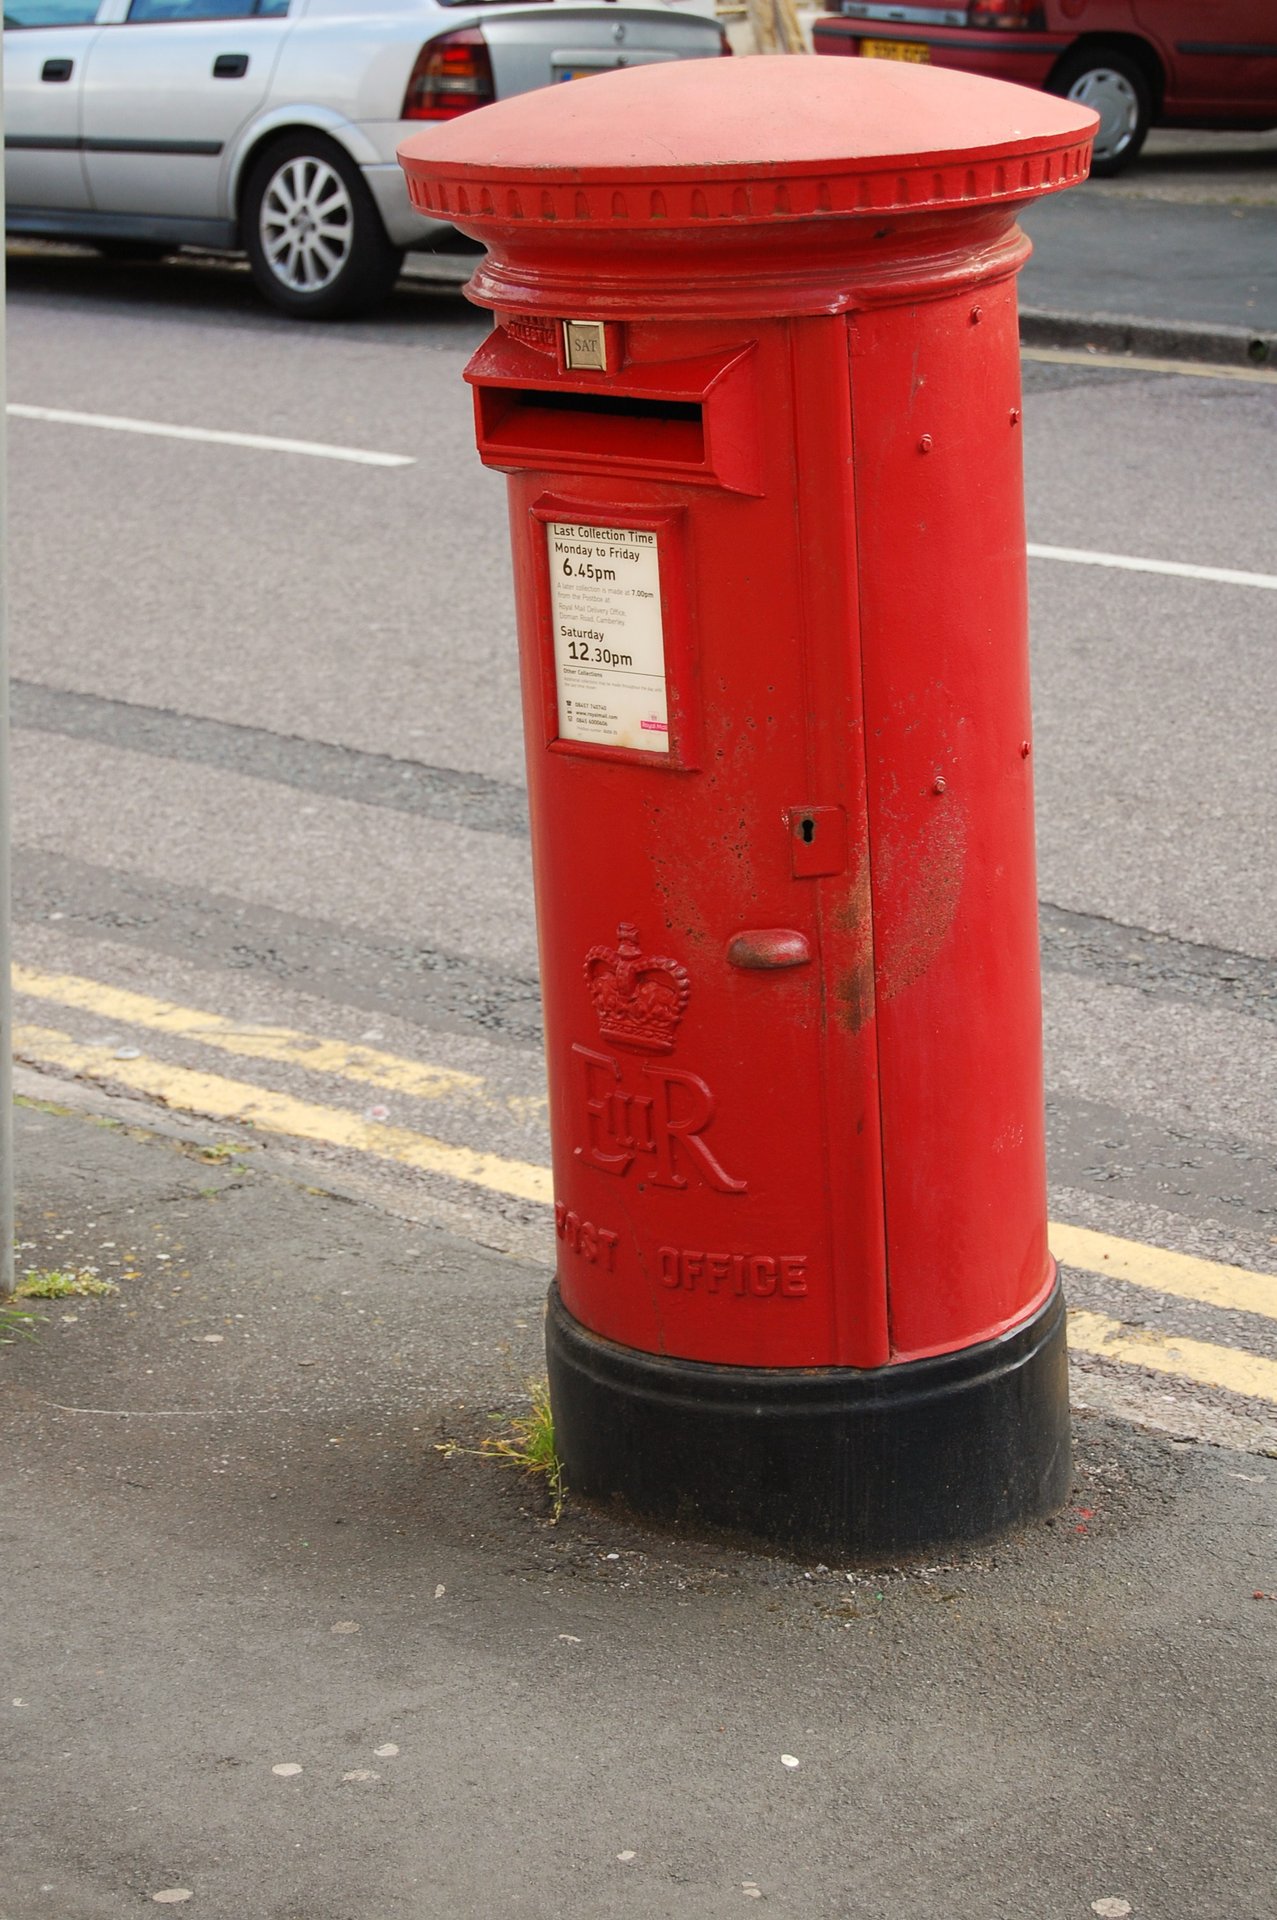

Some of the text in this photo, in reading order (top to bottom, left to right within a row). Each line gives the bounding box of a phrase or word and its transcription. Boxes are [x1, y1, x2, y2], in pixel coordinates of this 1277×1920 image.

[575, 338, 598, 352] SAT
[554, 525, 654, 544] Last Collection Time
[555, 543, 640, 562] Monday to Friday
[563, 558, 616, 582] 6.45pm
[632, 589, 654, 599] 7.00pm
[560, 625, 605, 642] Saturday
[568, 641, 633, 668] 12.30pm
[563, 667, 603, 678] Other Collections
[576, 711, 618, 720] www.royalmail.com
[657, 1246, 809, 1298] OFFICE
